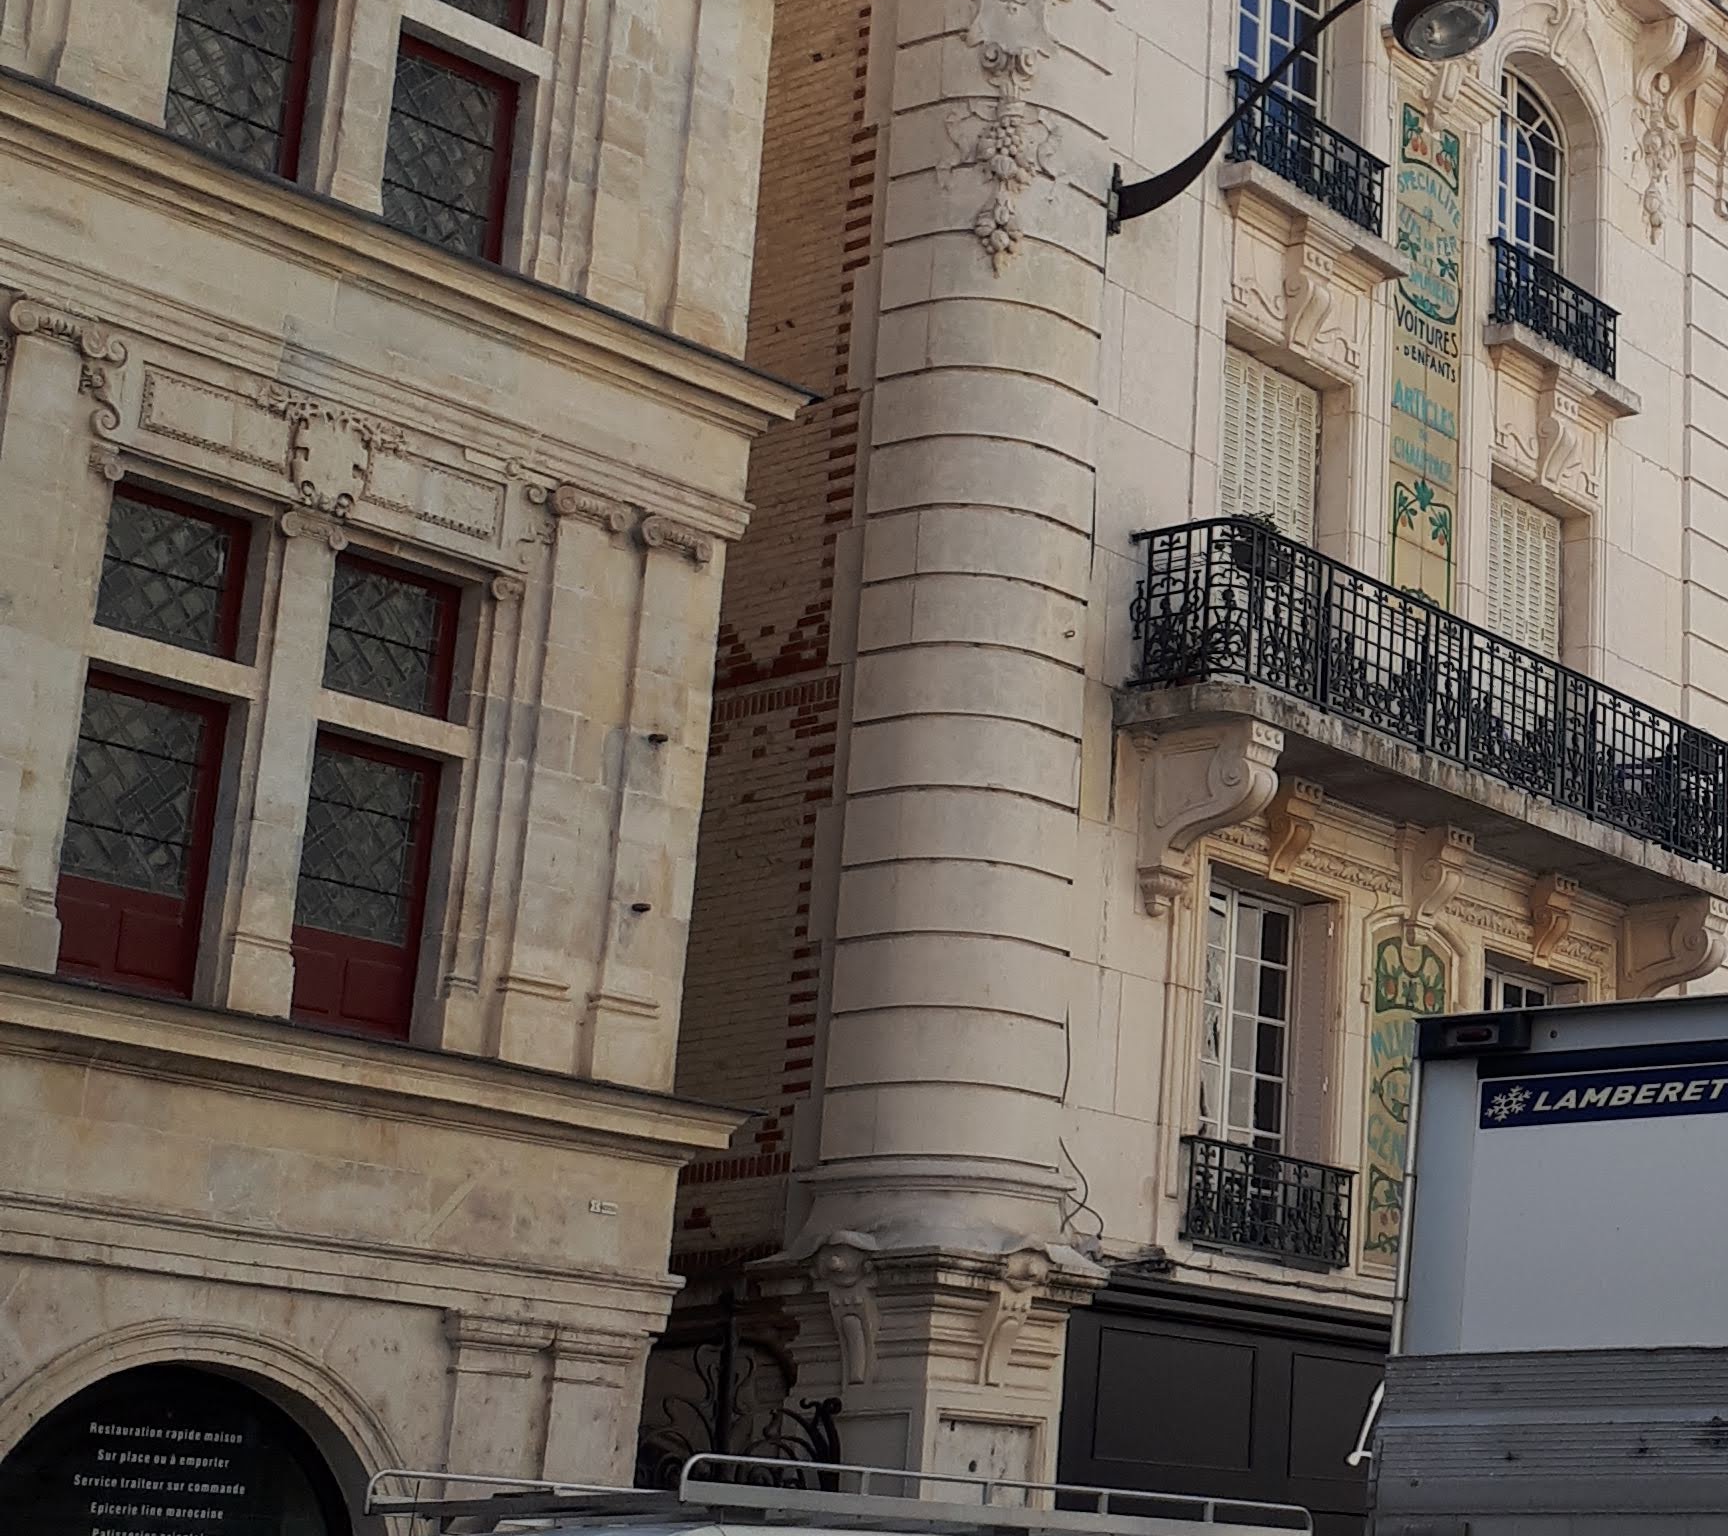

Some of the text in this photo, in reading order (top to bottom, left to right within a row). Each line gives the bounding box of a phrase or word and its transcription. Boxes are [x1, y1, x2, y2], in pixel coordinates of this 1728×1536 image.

[1394, 294, 1459, 359] VOITURES
[1393, 377, 1456, 440] ARTICLES
[90, 1422, 243, 1444] Restauration rapide maison
[97, 1449, 230, 1469] Sur place ou à emporter
[74, 1474, 246, 1495] Service traiteur sur commande
[141, 1504, 163, 1515] fine
[165, 1507, 224, 1520] marocaine
